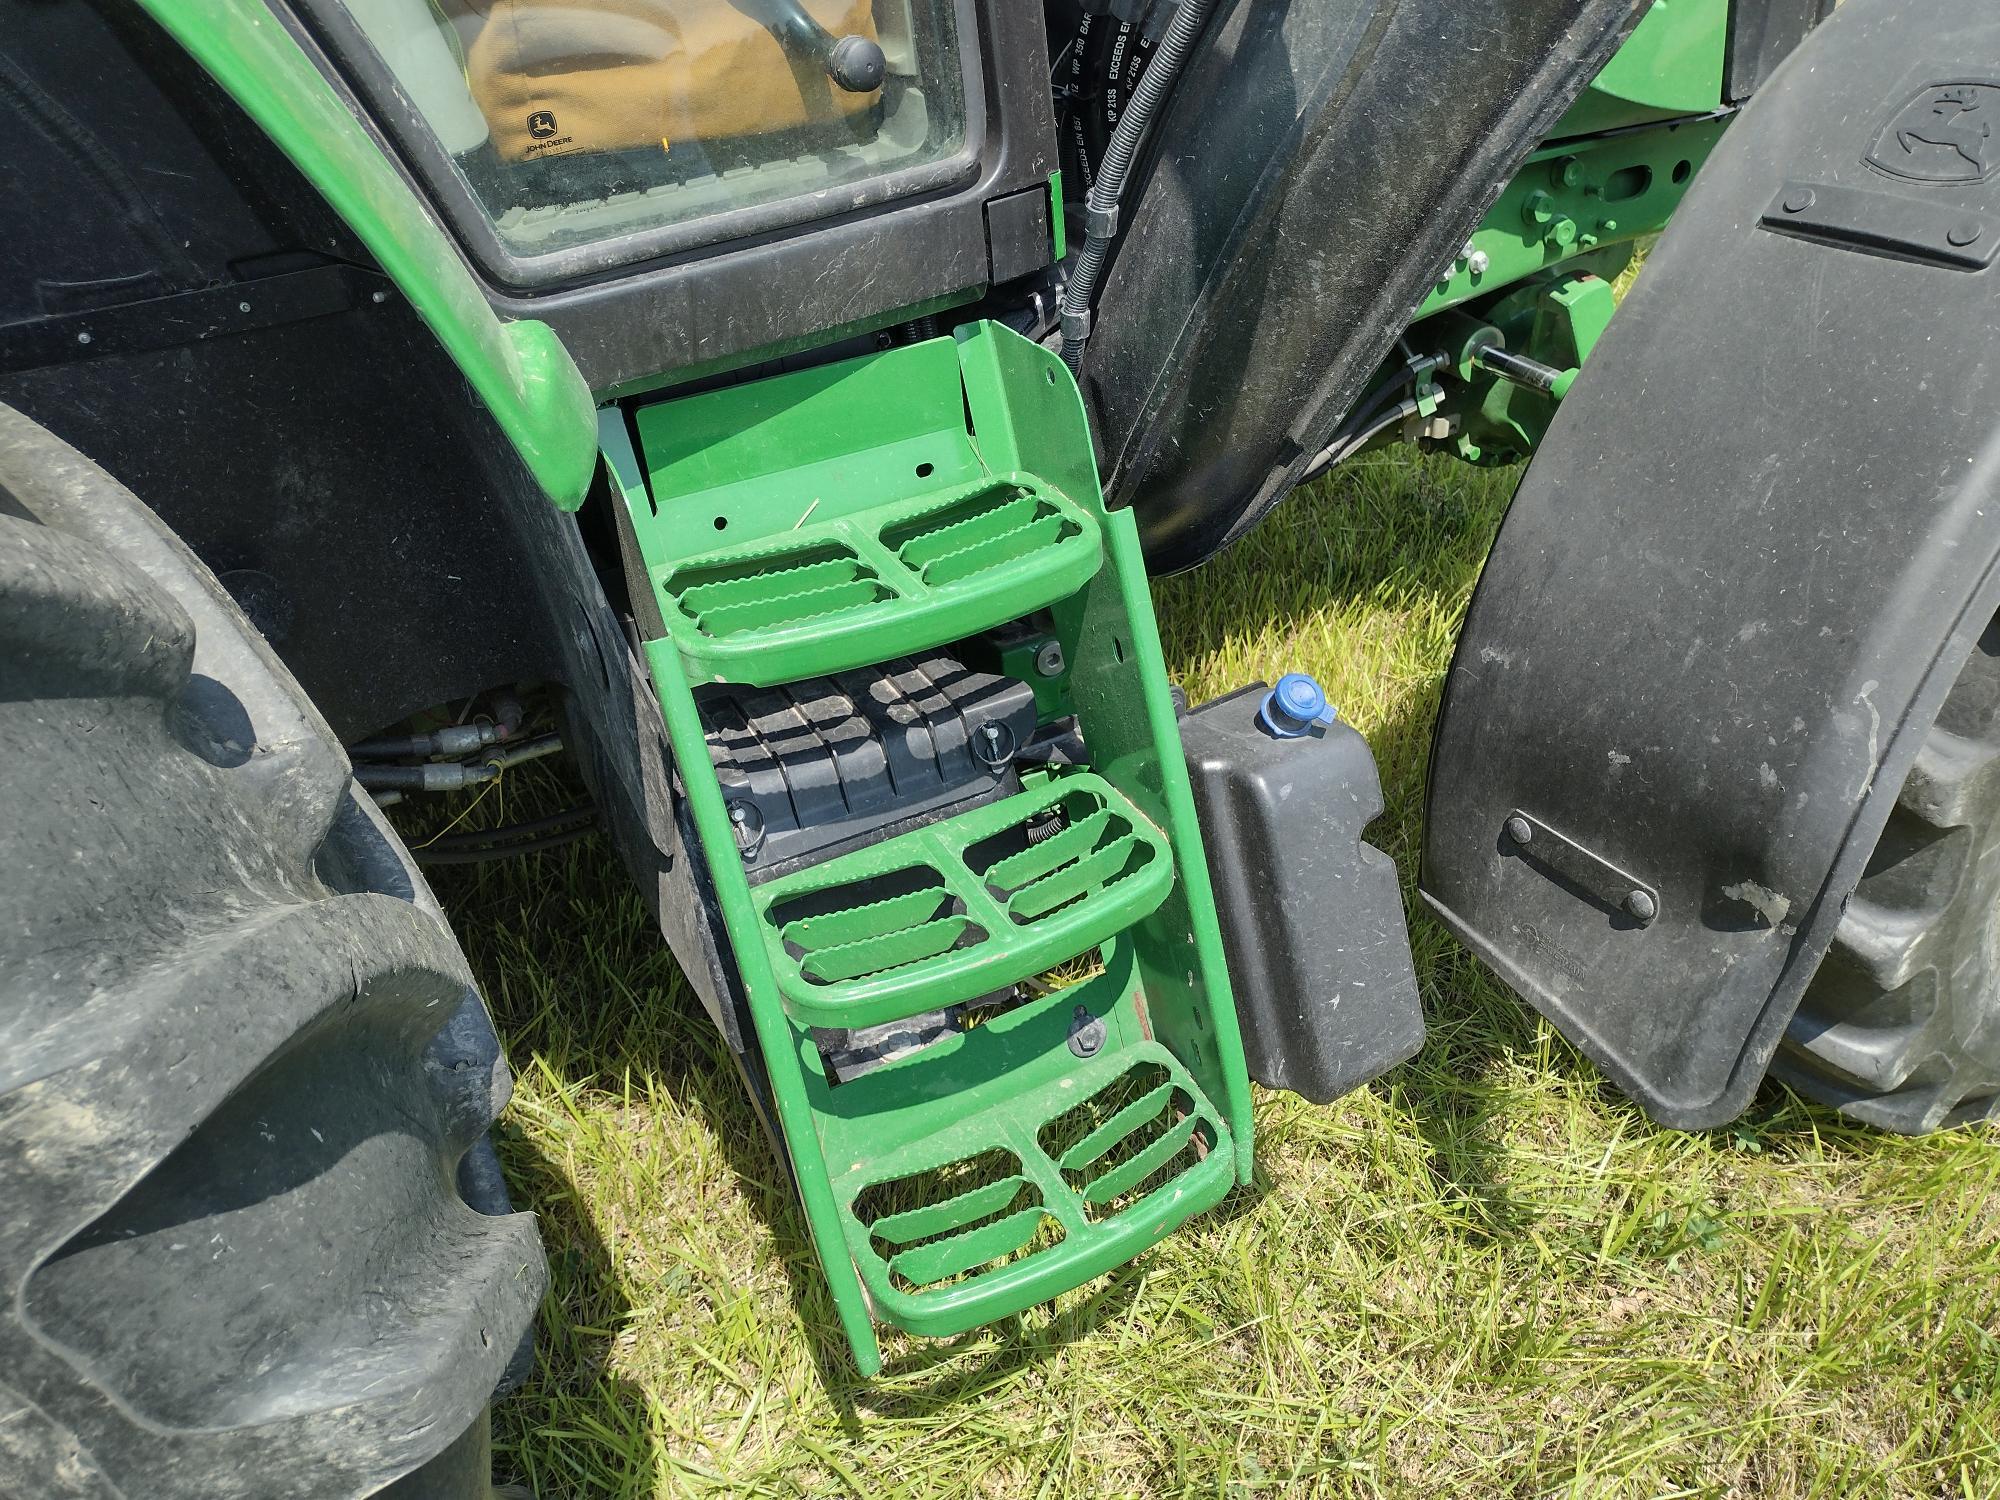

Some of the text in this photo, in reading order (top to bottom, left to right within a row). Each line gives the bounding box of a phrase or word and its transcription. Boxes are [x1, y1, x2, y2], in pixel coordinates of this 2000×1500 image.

[1080, 12, 1093, 35] BAR
[1075, 38, 1085, 56] 350
[1109, 35, 1127, 79] EXCEEDS
[1128, 55, 1141, 77] 213S
[1072, 59, 1080, 75] WP
[1107, 88, 1117, 108] 213S
[1107, 110, 1117, 122] KP
[525, 143, 547, 154] JOHN
[547, 137, 573, 148] DEERE
[1075, 133, 1084, 146] EN
